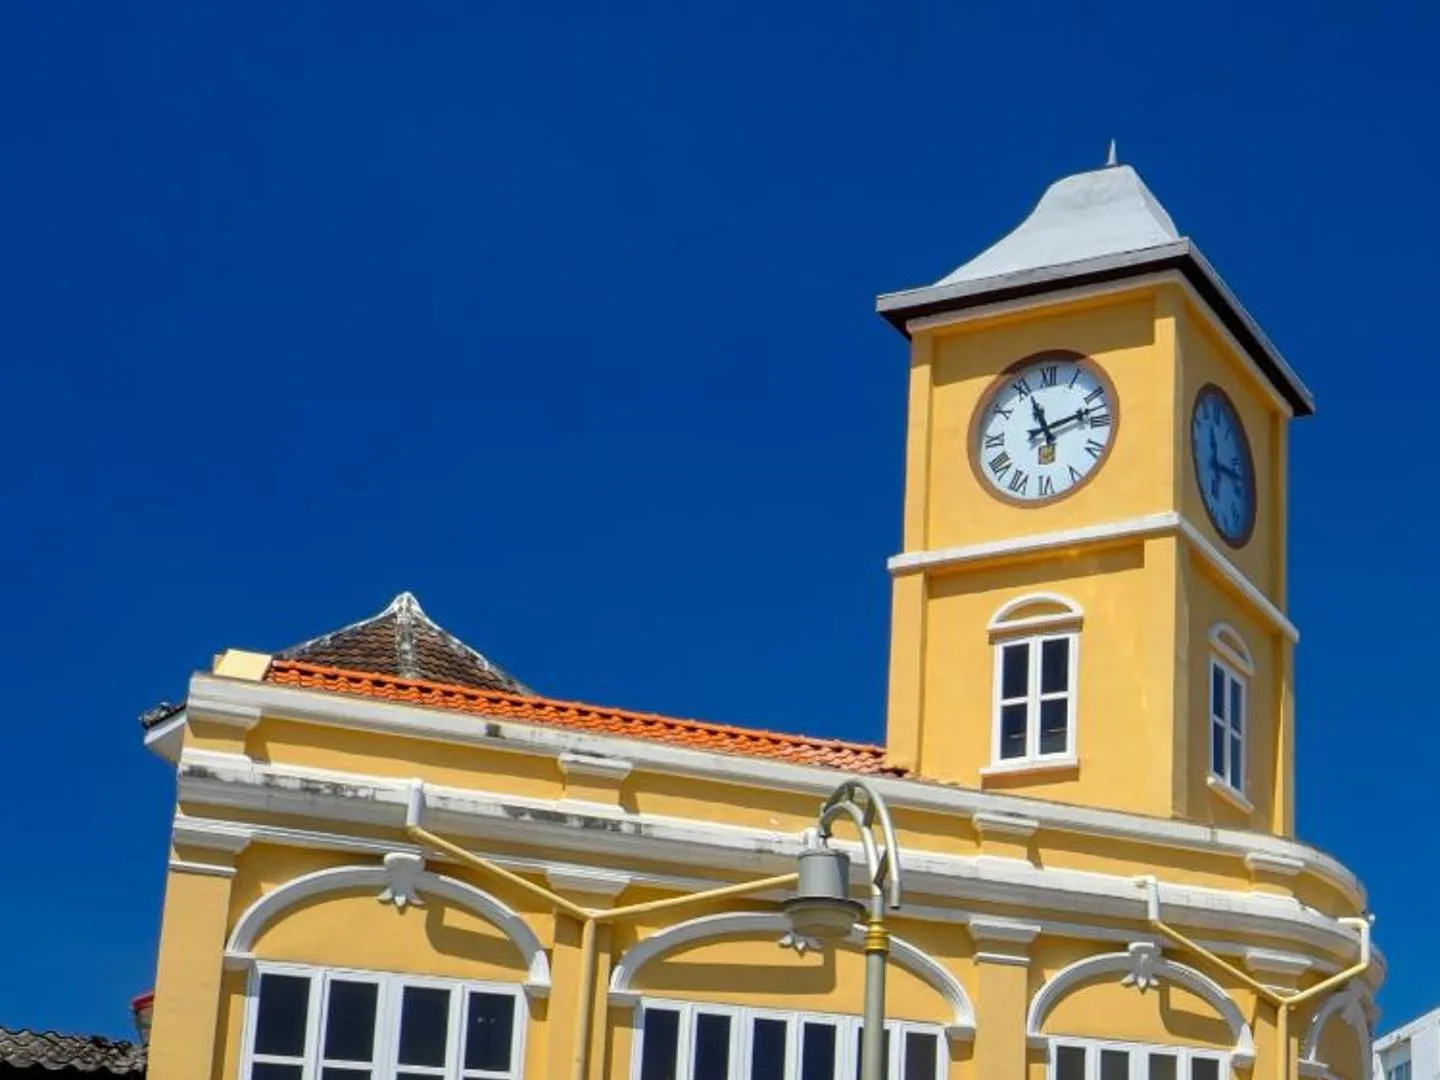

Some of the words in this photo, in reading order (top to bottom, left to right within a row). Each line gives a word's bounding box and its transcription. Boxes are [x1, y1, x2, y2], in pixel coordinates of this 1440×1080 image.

[1039, 366, 1057, 388] XII
[1083, 386, 1104, 405] II
[1090, 414, 1111, 429] III
[1008, 469, 1029, 496] VII
[1037, 475, 1056, 496] VI
